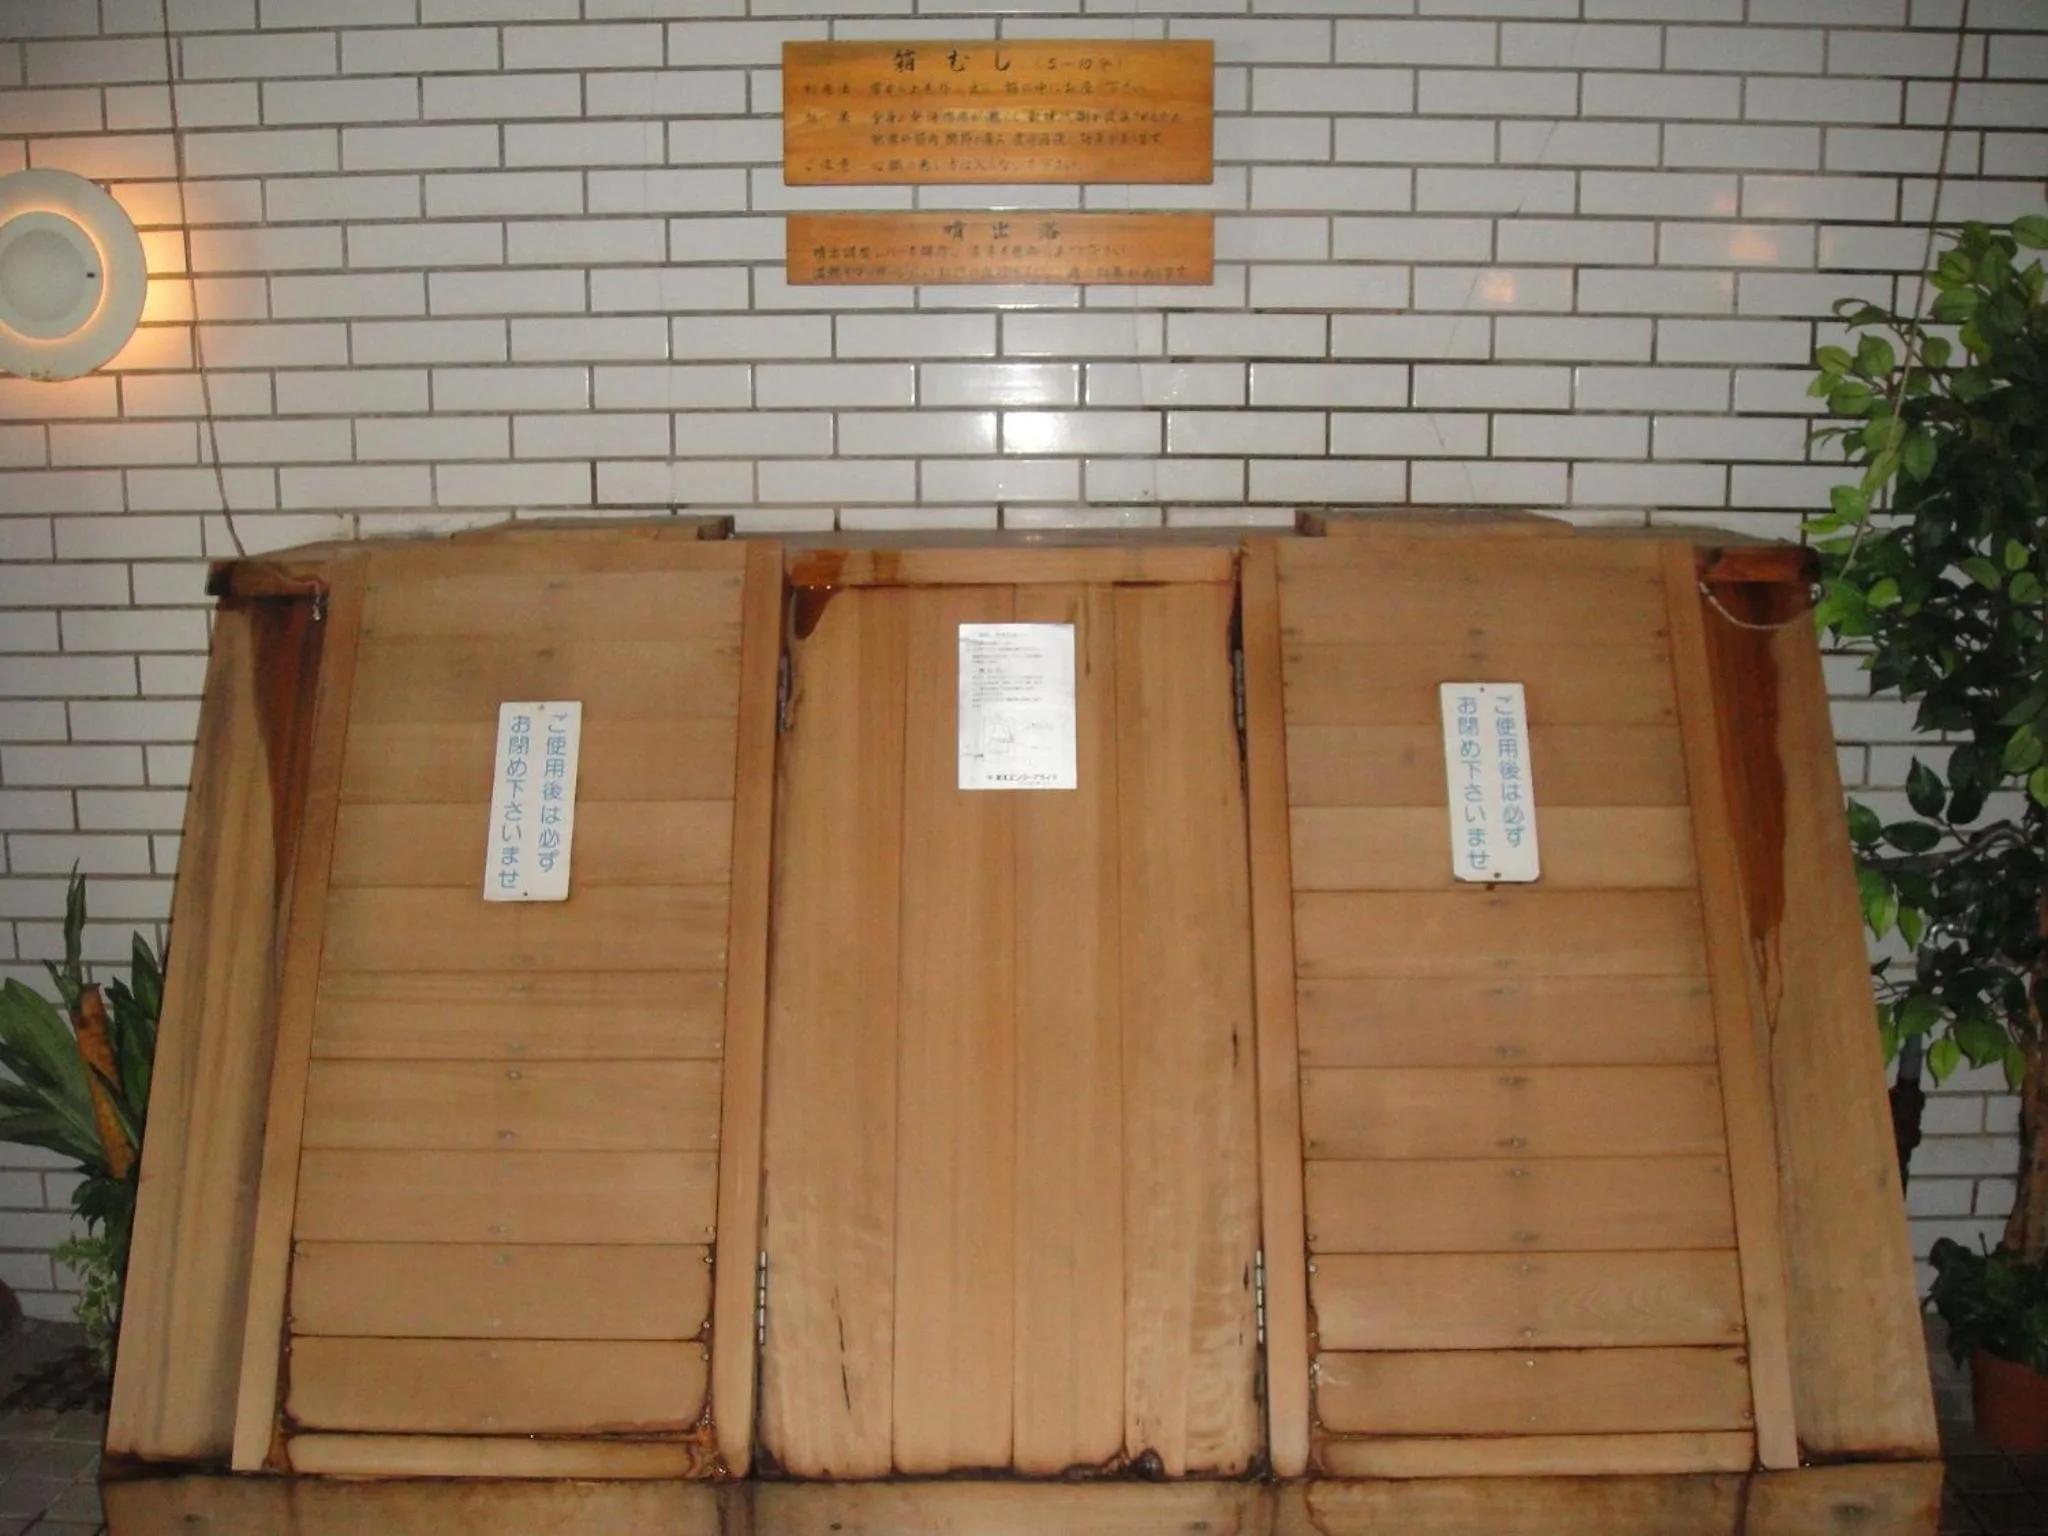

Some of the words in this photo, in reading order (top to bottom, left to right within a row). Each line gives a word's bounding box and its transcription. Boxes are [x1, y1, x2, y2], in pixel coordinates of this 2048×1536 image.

[498, 714, 532, 890] お閉め下さいませ
[538, 712, 568, 873] ご使用後は必ず
[1457, 696, 1490, 871] お閉め下さいませ
[1494, 695, 1525, 848] ご使用後は必ず
